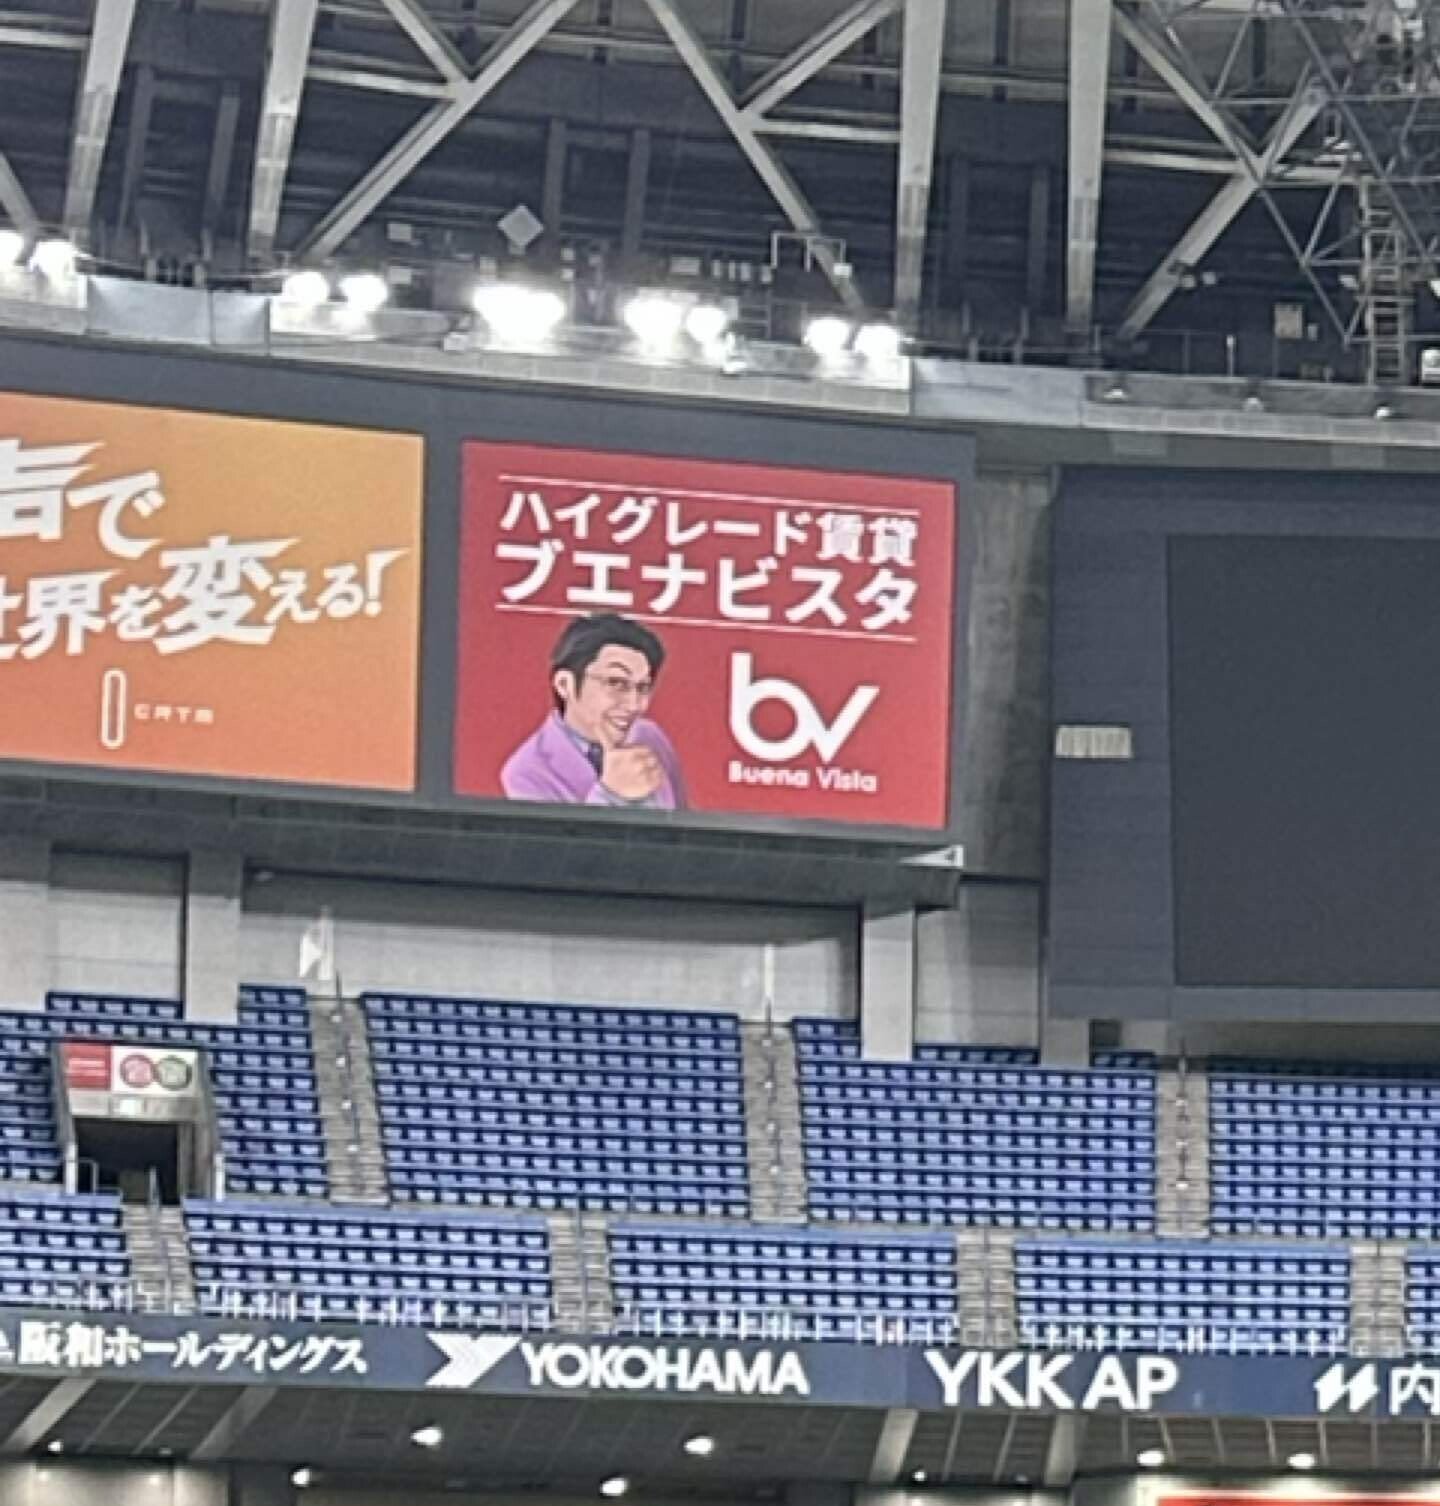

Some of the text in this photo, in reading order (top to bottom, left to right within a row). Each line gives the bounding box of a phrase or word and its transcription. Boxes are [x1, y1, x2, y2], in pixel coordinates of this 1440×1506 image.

[500, 491, 918, 567] ハイグレード賃貸
[494, 539, 919, 630] ブエナビスタ
[728, 760, 878, 793] Buena Vista
[522, 1342, 809, 1395] YOKOHAMA
[924, 1351, 1177, 1410] YKK AP
